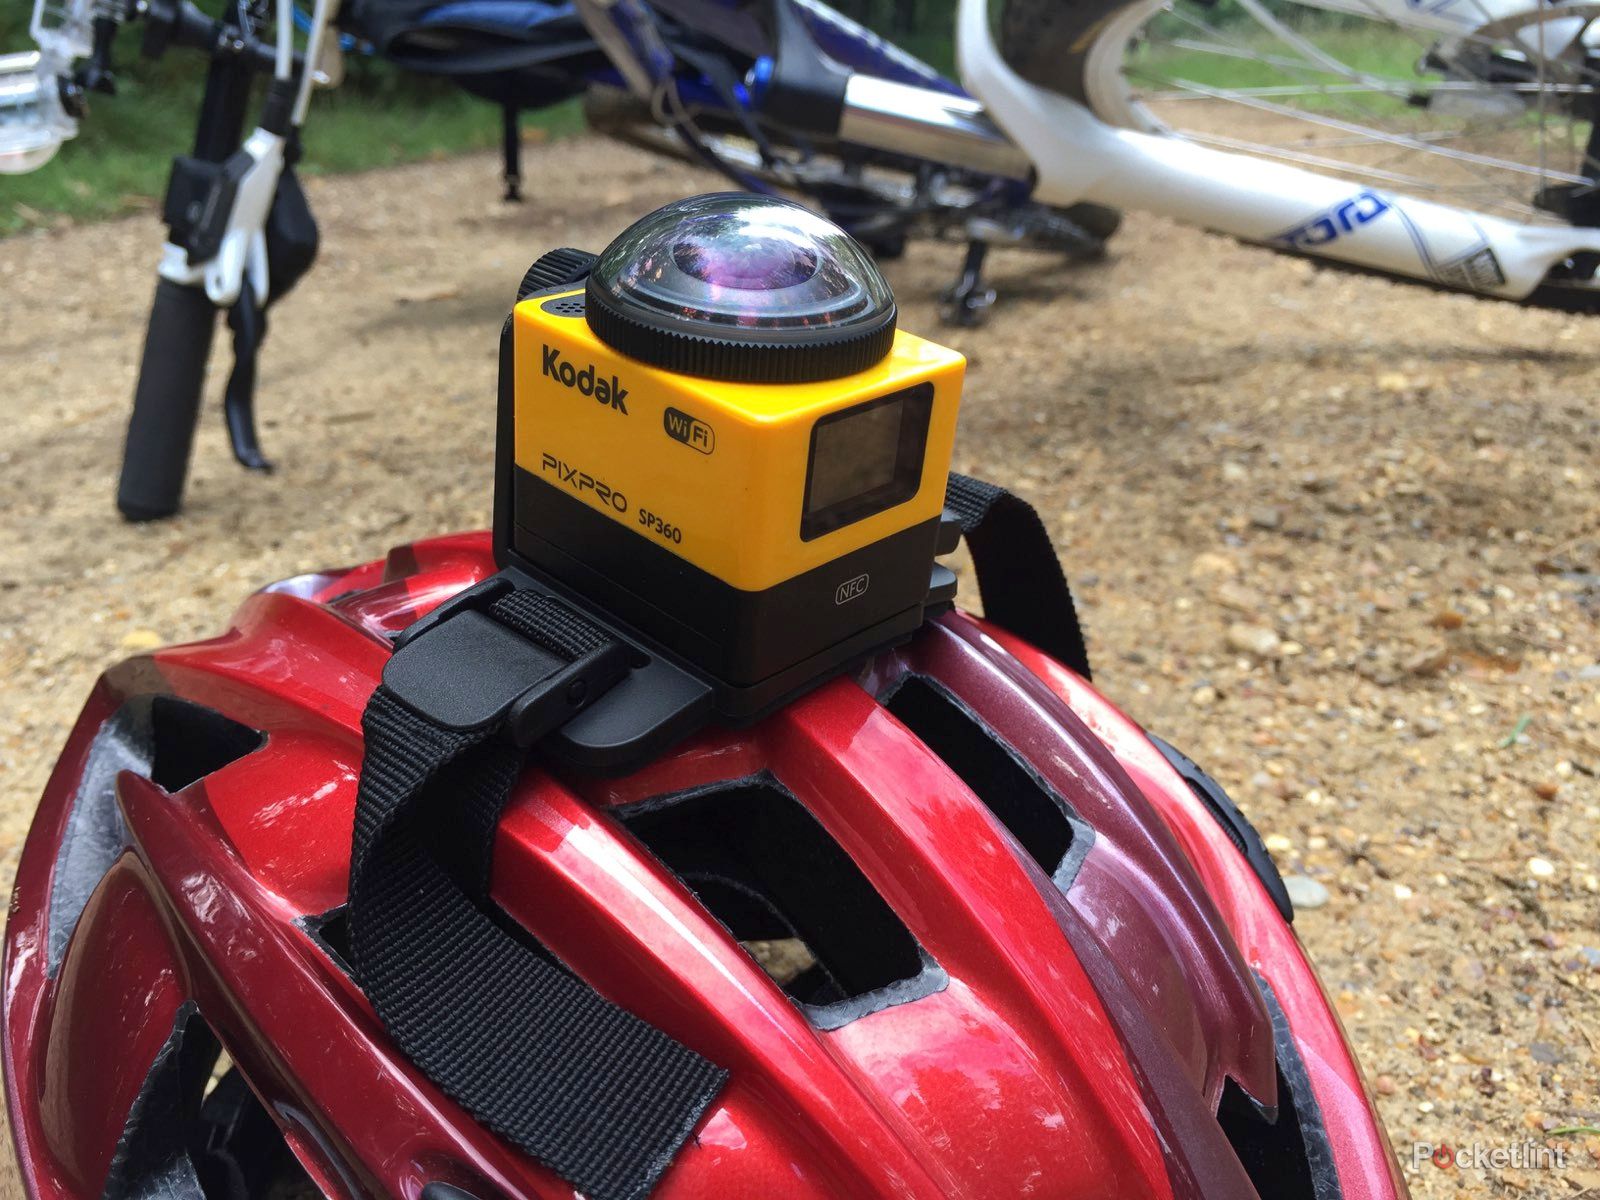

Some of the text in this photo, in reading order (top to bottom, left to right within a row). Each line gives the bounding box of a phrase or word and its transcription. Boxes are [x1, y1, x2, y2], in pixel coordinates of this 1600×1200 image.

[542, 343, 629, 416] Kodak
[542, 452, 682, 544] PIXPRO SP360
[839, 578, 865, 601] NFC
